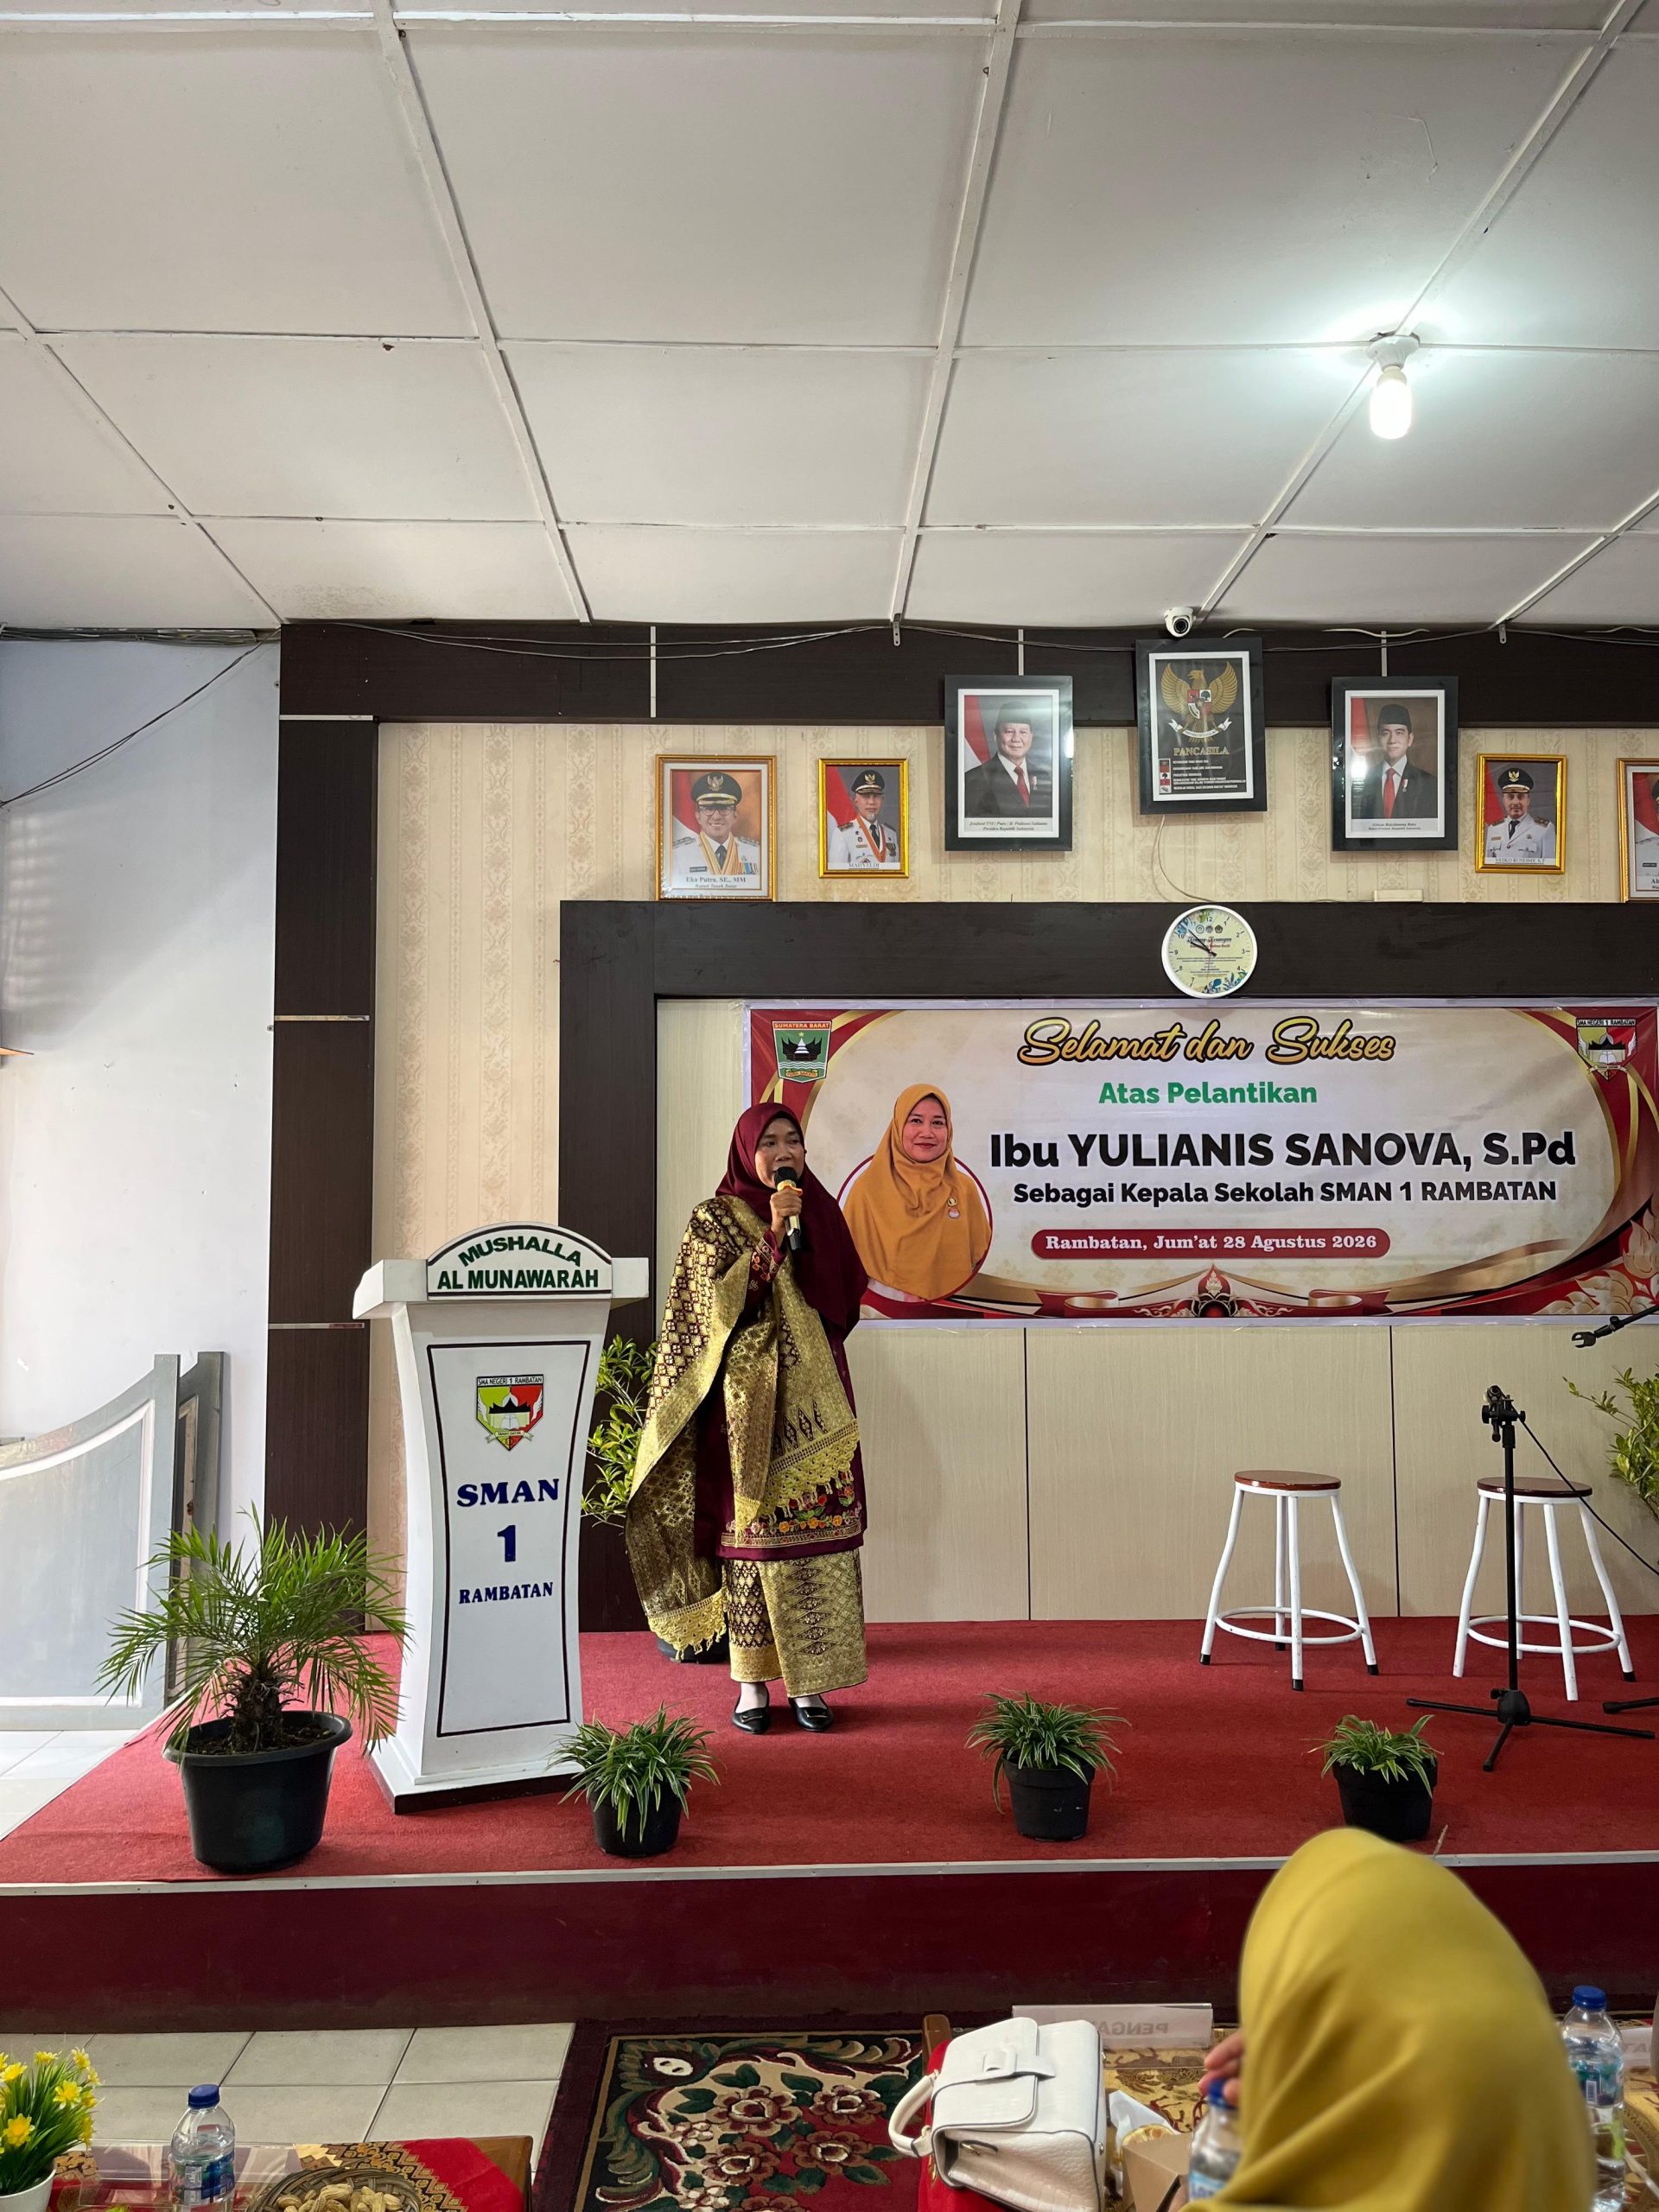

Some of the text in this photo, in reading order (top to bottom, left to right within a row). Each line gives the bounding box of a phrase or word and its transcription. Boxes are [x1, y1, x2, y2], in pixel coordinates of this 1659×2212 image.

[1173, 747, 1230, 756] PANCASILA
[1017, 1015, 1395, 1065] Selamat dan Sukses
[1099, 1081, 1317, 1103] Atas Pelantikan
[991, 1131, 1576, 1172] Ibu YULIANIS SANOVA, S.Pd
[1014, 1181, 1556, 1208] Sebagai Kepala Sekolah SMAN 1 RAMBATAN
[458, 1236, 582, 1267] MUSHALLA
[1046, 1236, 1147, 1251] Rambatan,
[1223, 1236, 1245, 1249] 28
[1250, 1235, 1326, 1251] Agustus
[1332, 1235, 1377, 1249] 2026
[437, 1269, 598, 1289] AL MUNAWARAH
[457, 1478, 559, 1507] SMAN
[498, 1525, 516, 1562] 1
[459, 1582, 553, 1604] RAMBATAN
